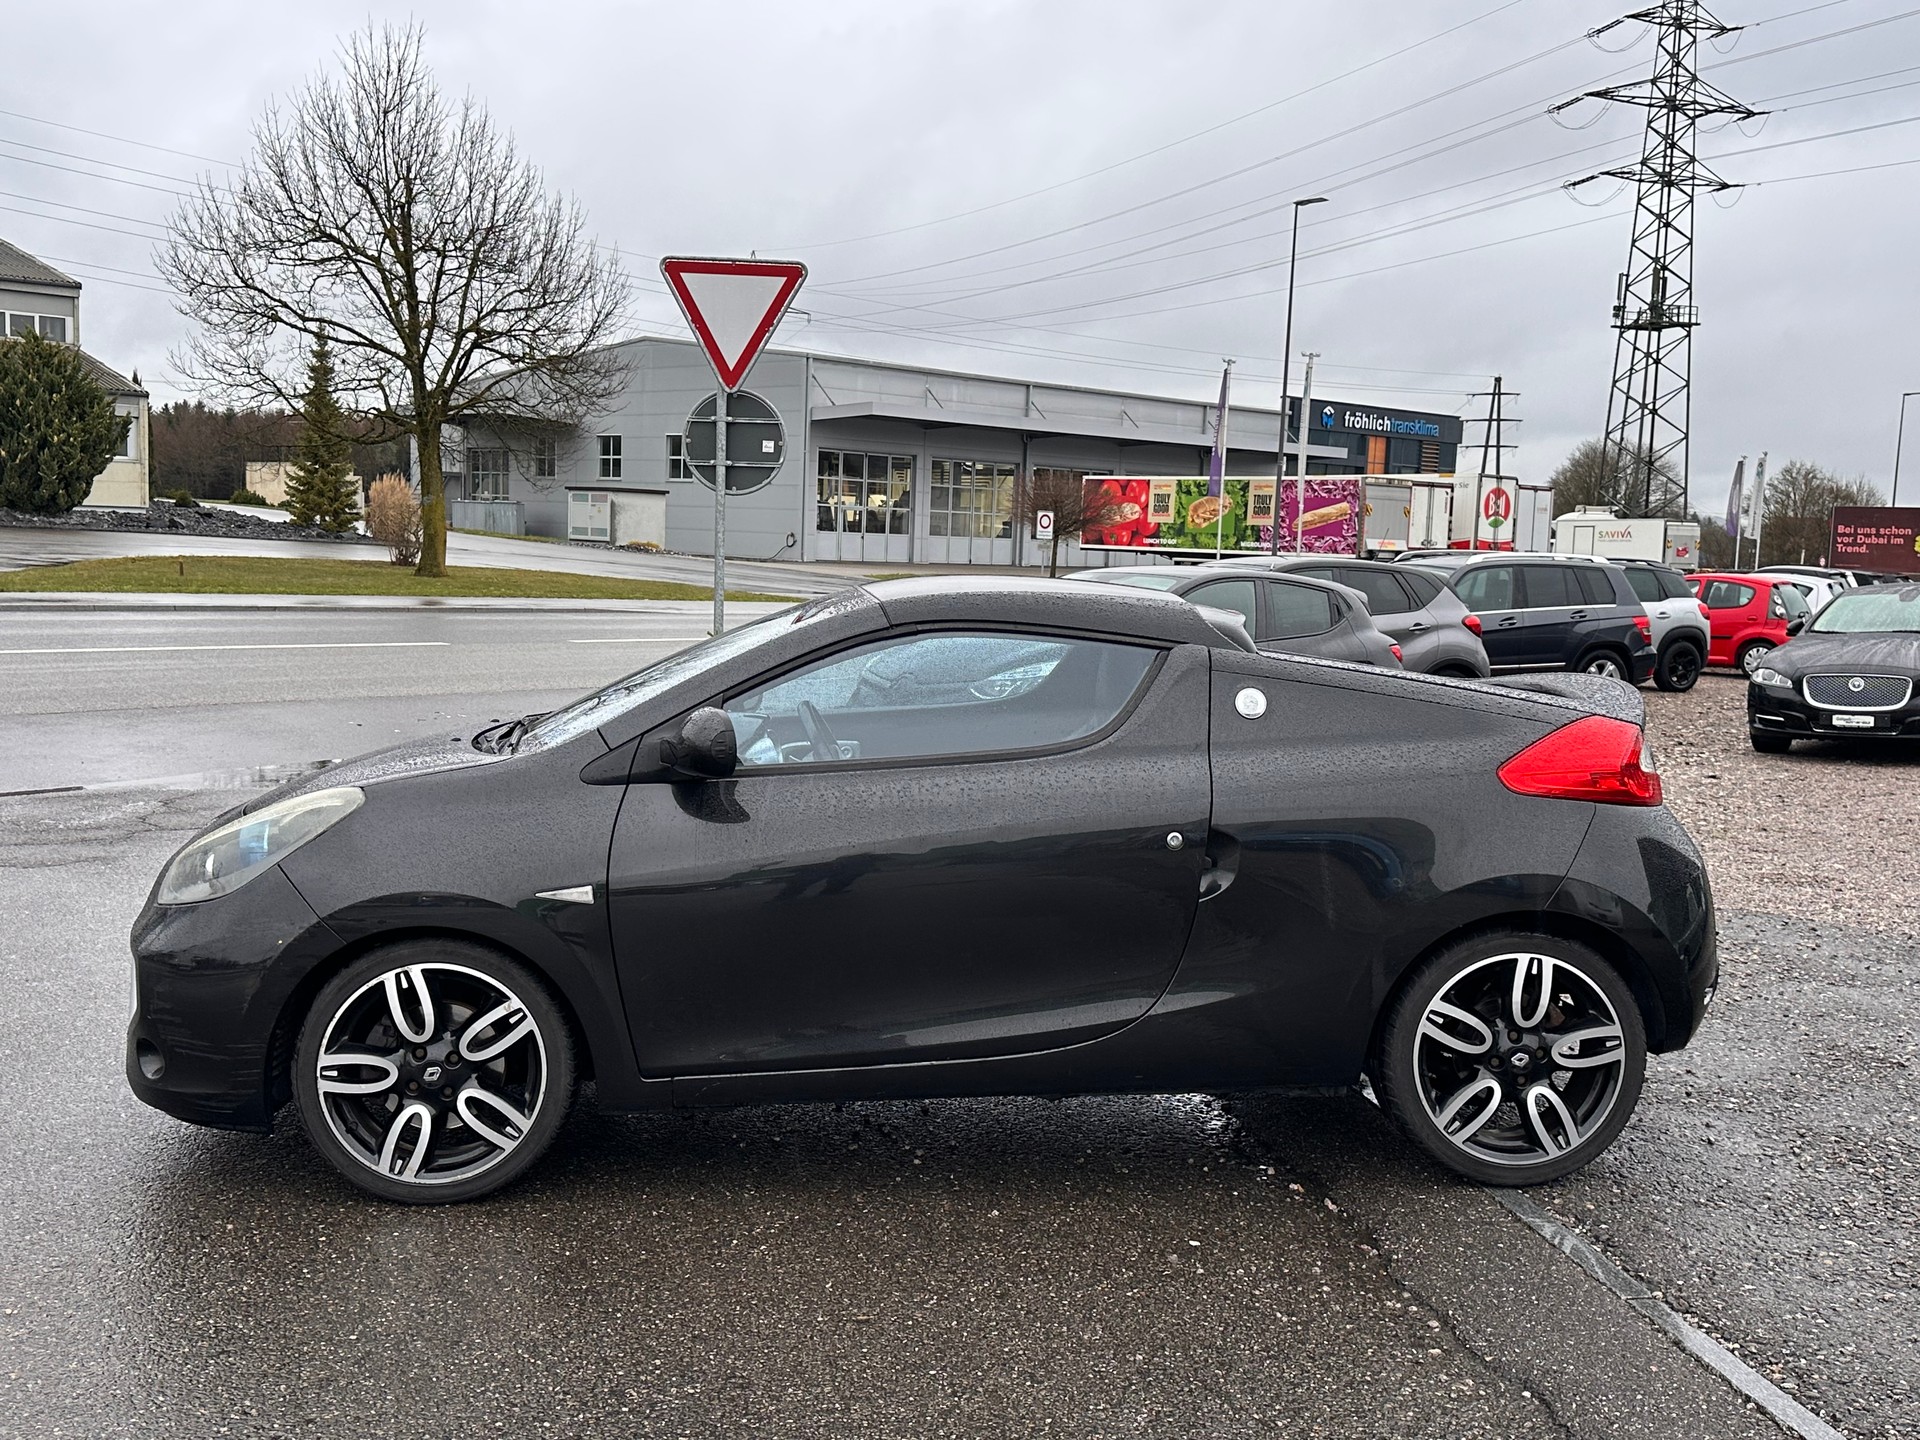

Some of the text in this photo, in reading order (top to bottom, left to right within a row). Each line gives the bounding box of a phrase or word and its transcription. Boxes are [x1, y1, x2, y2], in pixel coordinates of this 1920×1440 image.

[1344, 411, 1439, 437] fröhlichtransklima
[1153, 493, 1171, 504] TRULY
[1253, 494, 1273, 505] TRULY
[1153, 503, 1170, 513] GOOD
[1488, 492, 1506, 517] Bell
[1253, 505, 1271, 516] GOOD
[1598, 525, 1632, 539] SAVIVA
[1837, 524, 1912, 535] Bei uns schon
[1856, 535, 1888, 544] Dubai
[1890, 536, 1904, 545] im
[1835, 543, 1869, 553] Trend.
